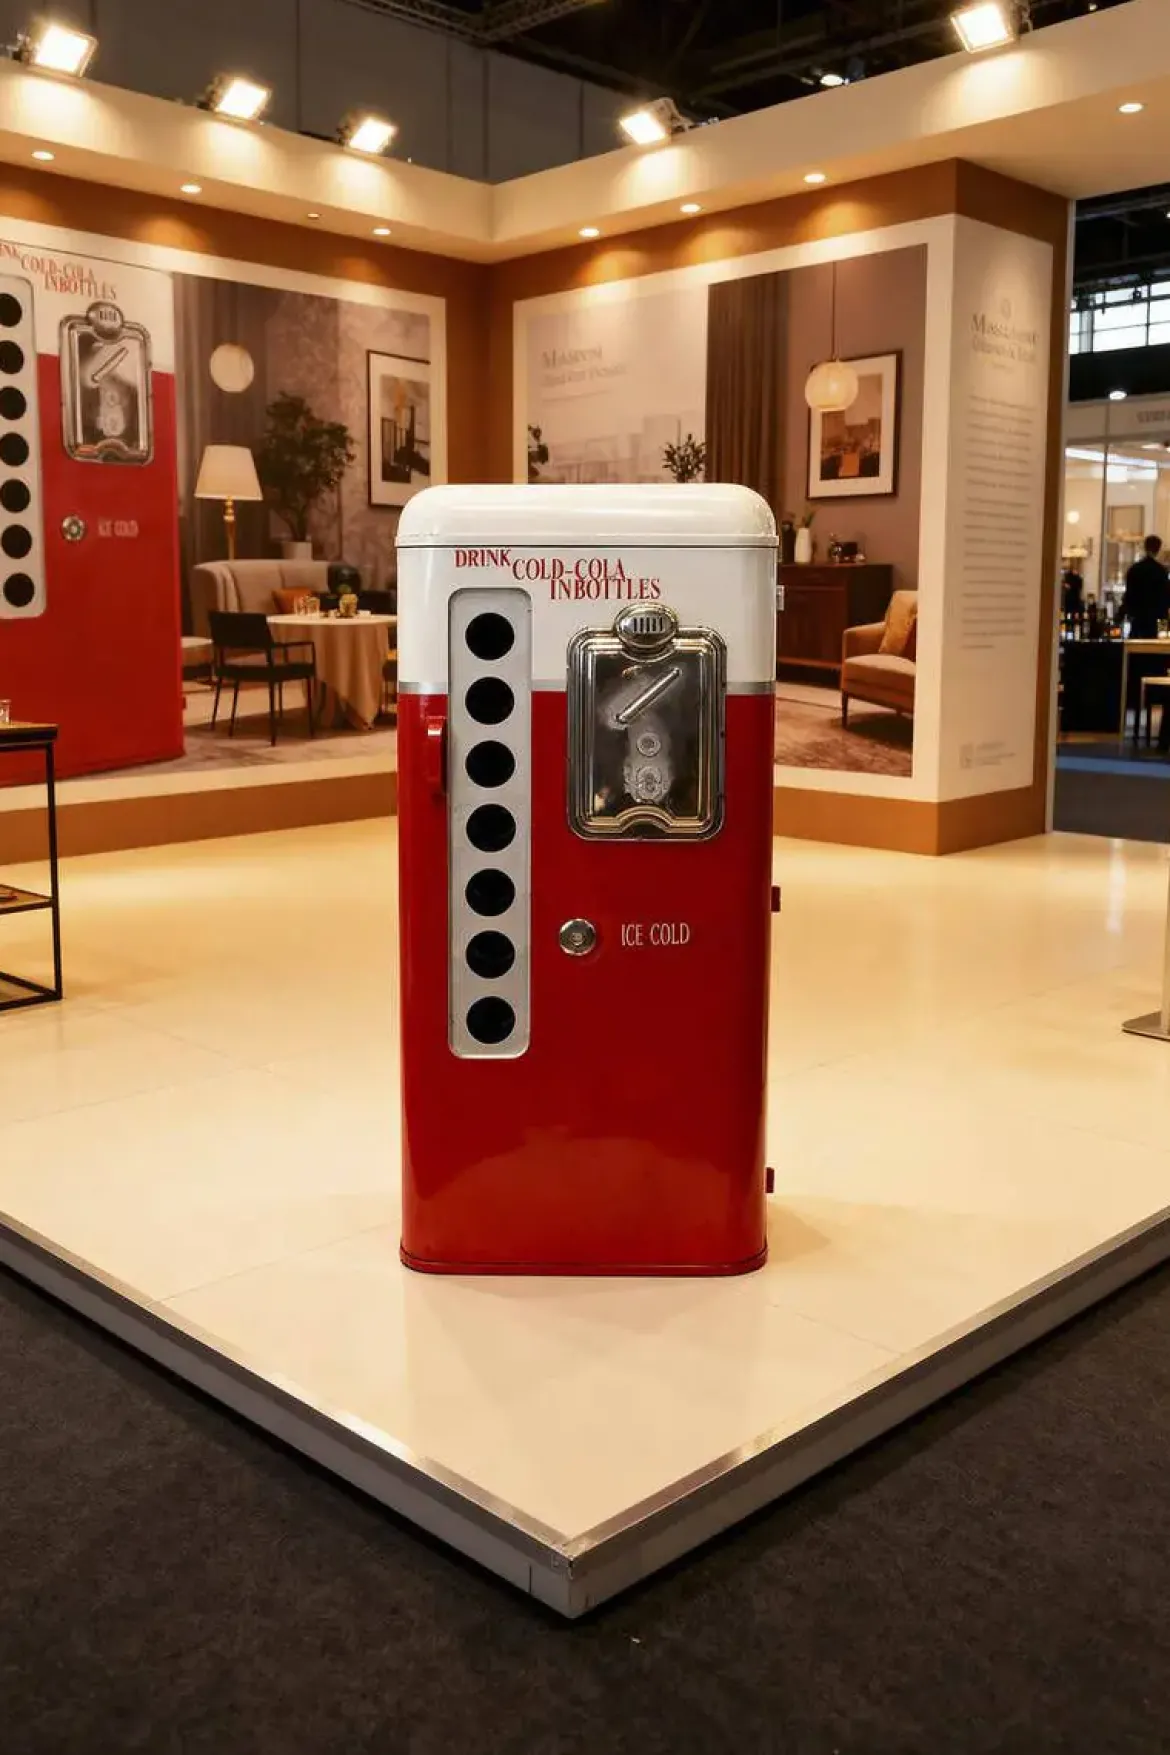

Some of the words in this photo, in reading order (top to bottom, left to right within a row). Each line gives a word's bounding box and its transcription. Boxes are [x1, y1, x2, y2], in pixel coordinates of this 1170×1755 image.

[455, 549, 511, 568] DRINK
[512, 558, 625, 581] COLD-COLA
[621, 923, 644, 946] ICE
[650, 922, 690, 945] COLD
